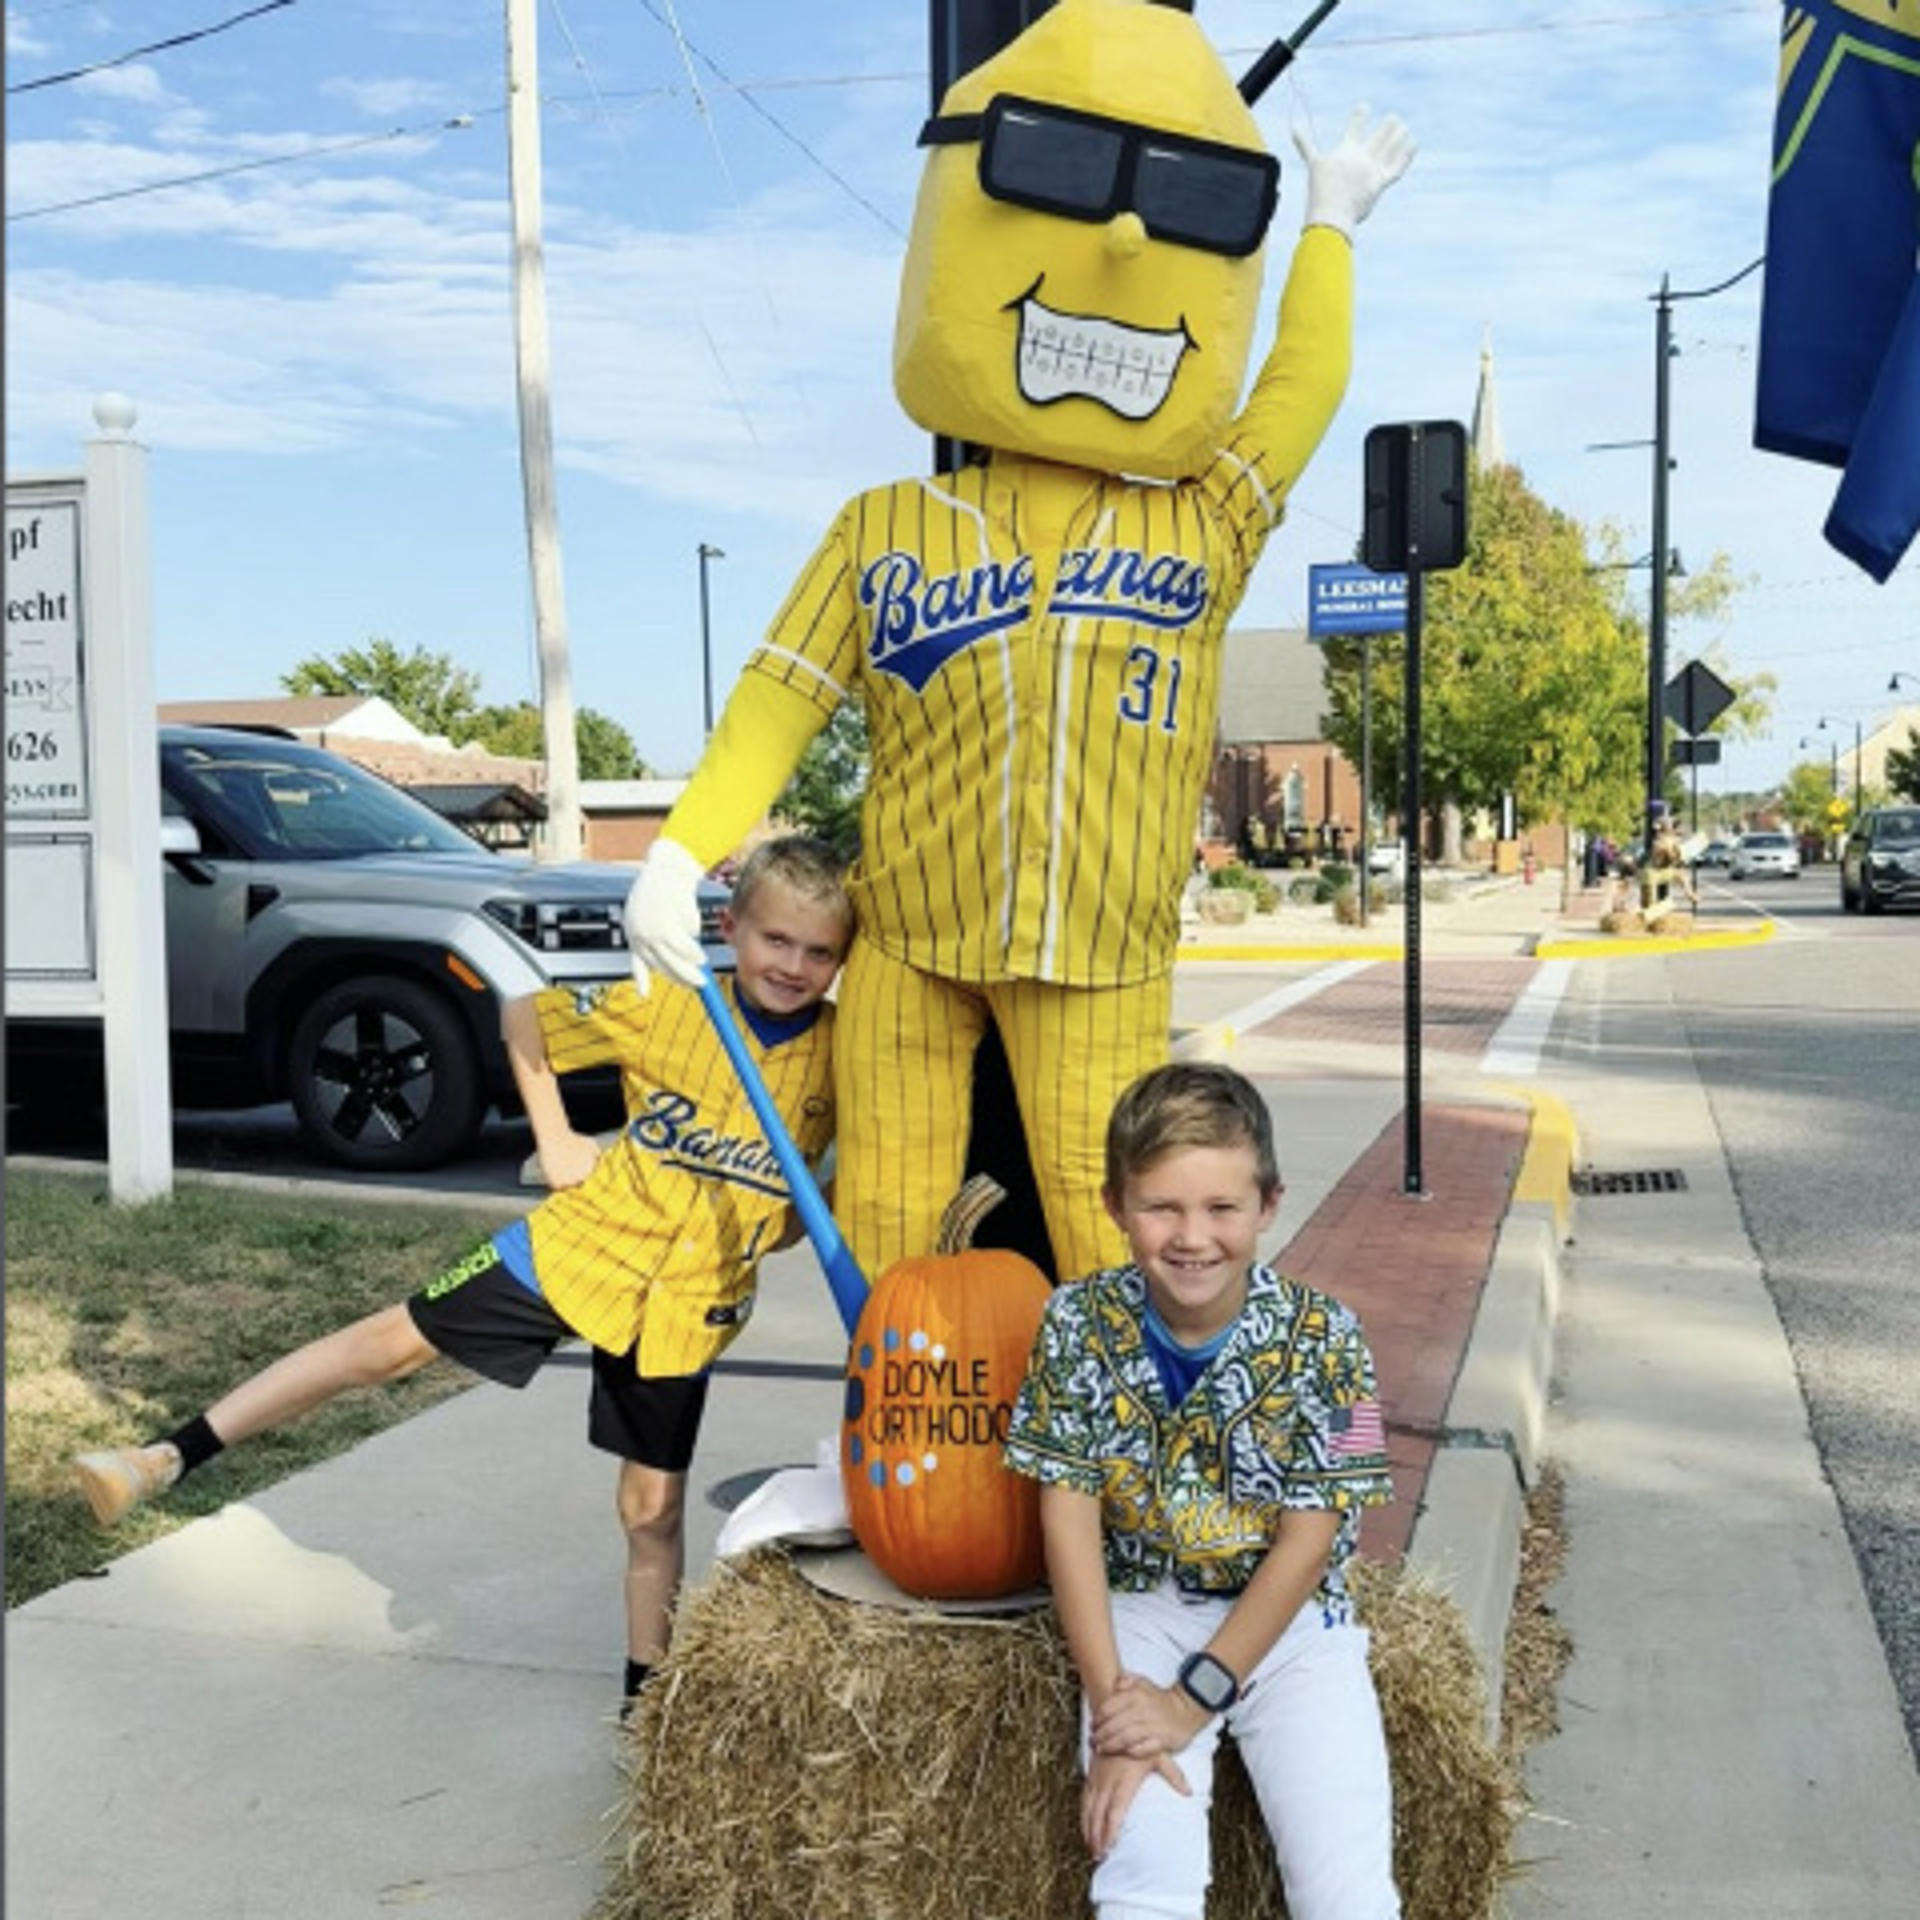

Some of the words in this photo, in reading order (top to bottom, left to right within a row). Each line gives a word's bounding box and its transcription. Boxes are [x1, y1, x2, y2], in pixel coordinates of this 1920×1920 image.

[11, 516, 42, 560] pf
[7, 590, 67, 621] echt
[1119, 643, 1182, 732] 31
[8, 731, 58, 761] 626
[884, 1359, 989, 1397] DOYLE
